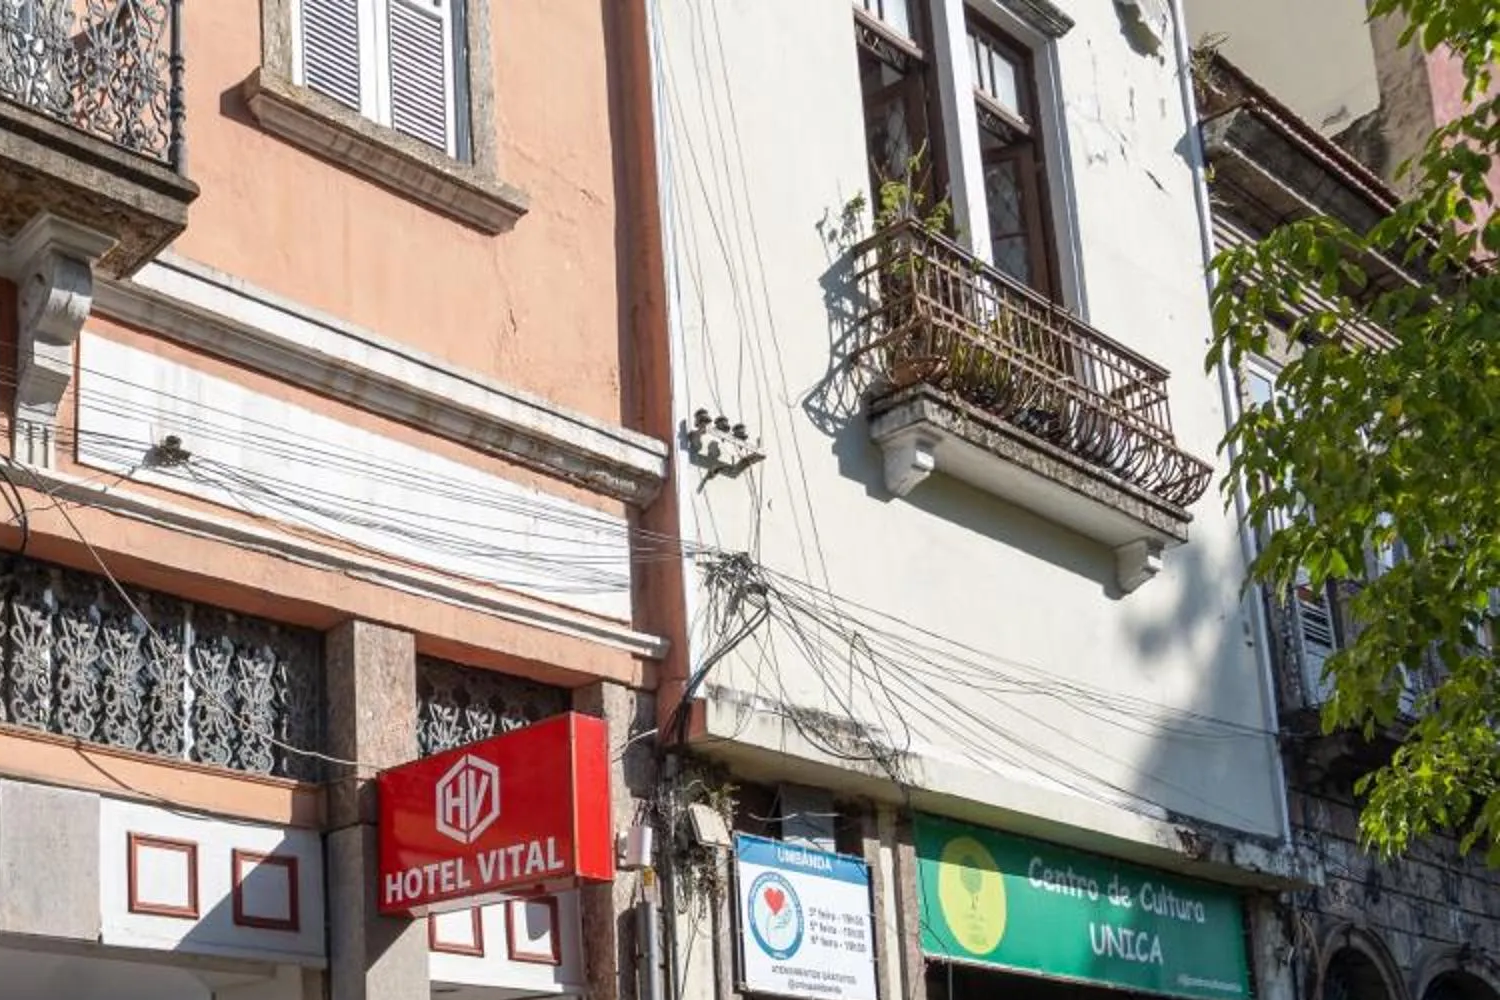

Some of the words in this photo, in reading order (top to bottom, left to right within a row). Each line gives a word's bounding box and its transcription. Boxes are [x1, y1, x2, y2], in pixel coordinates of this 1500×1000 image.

[385, 857, 472, 903] HOTEL
[477, 836, 565, 884] VITAL
[1027, 856, 1099, 901] Centro
[1108, 874, 1133, 909] de
[1139, 882, 1206, 924] Cultura
[1089, 922, 1164, 965] UNICA
